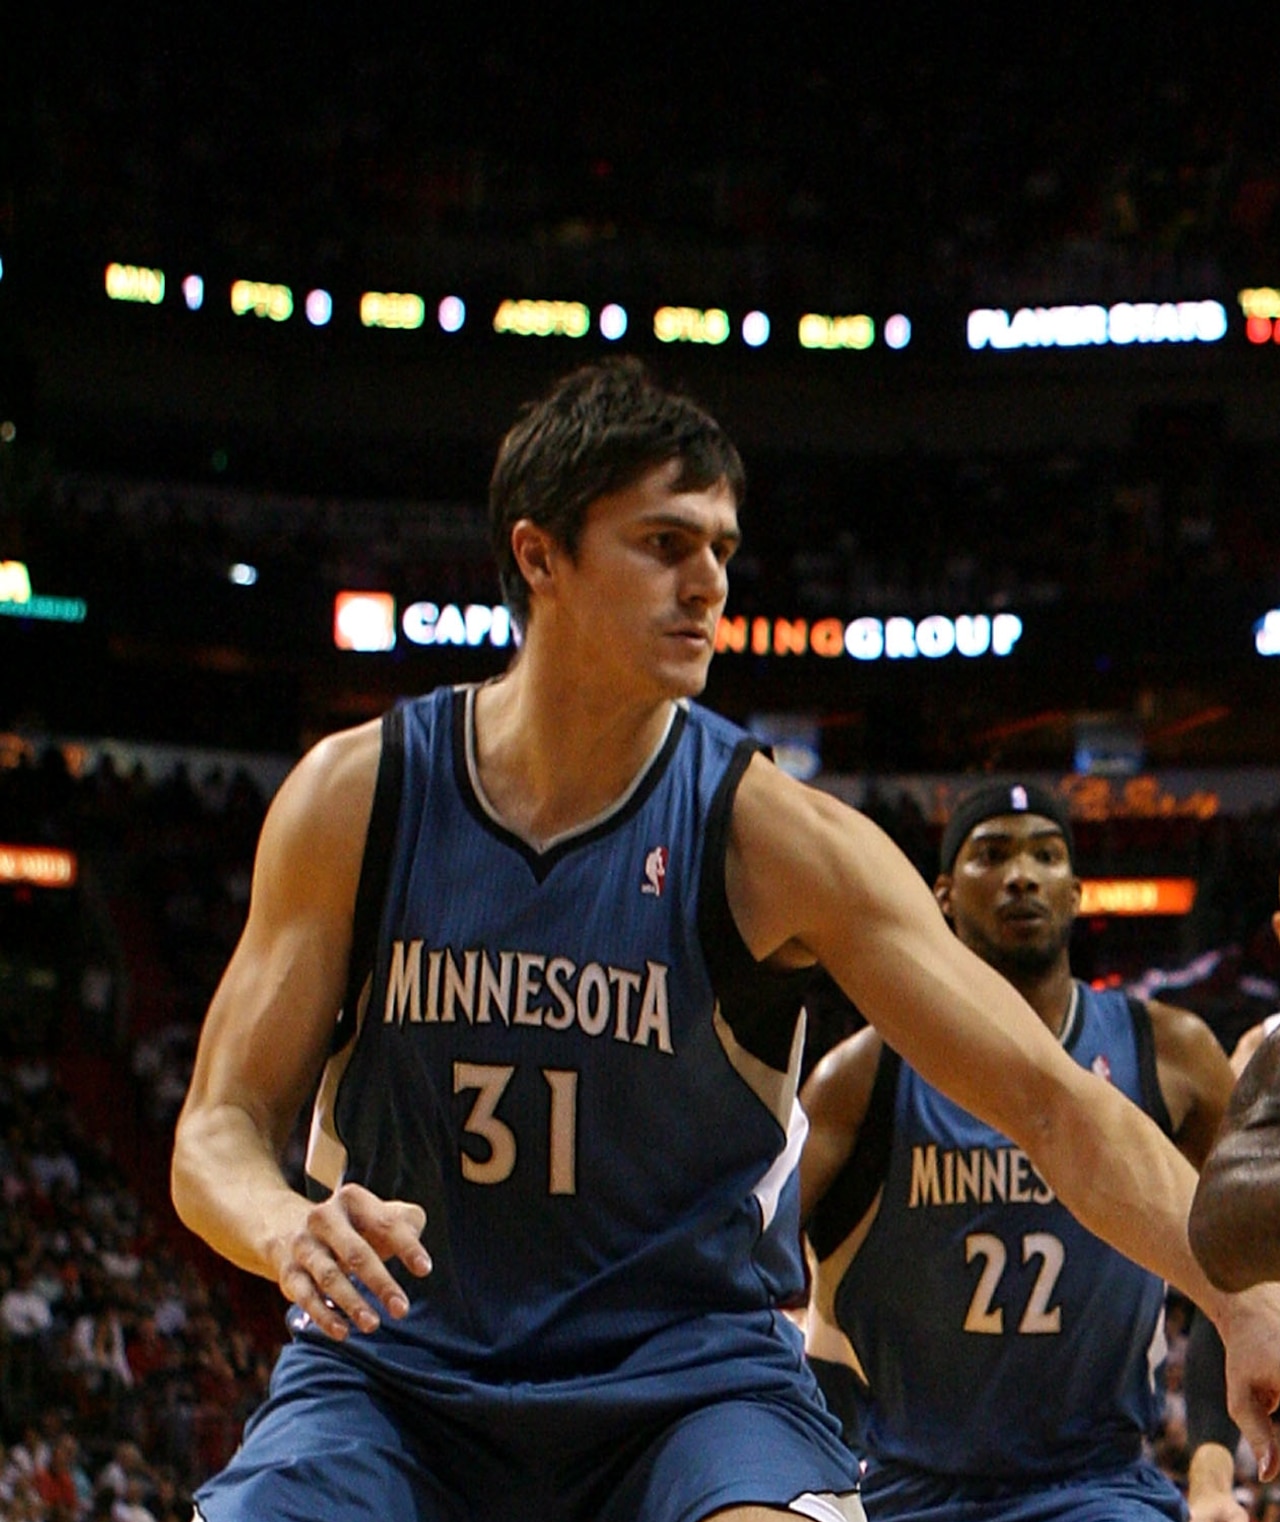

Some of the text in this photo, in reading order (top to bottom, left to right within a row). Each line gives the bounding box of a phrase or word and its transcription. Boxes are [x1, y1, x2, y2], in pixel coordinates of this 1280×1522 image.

[383, 937, 675, 1055] MINNESOTA
[453, 1061, 580, 1196] 31
[963, 1232, 1065, 1335] 22
